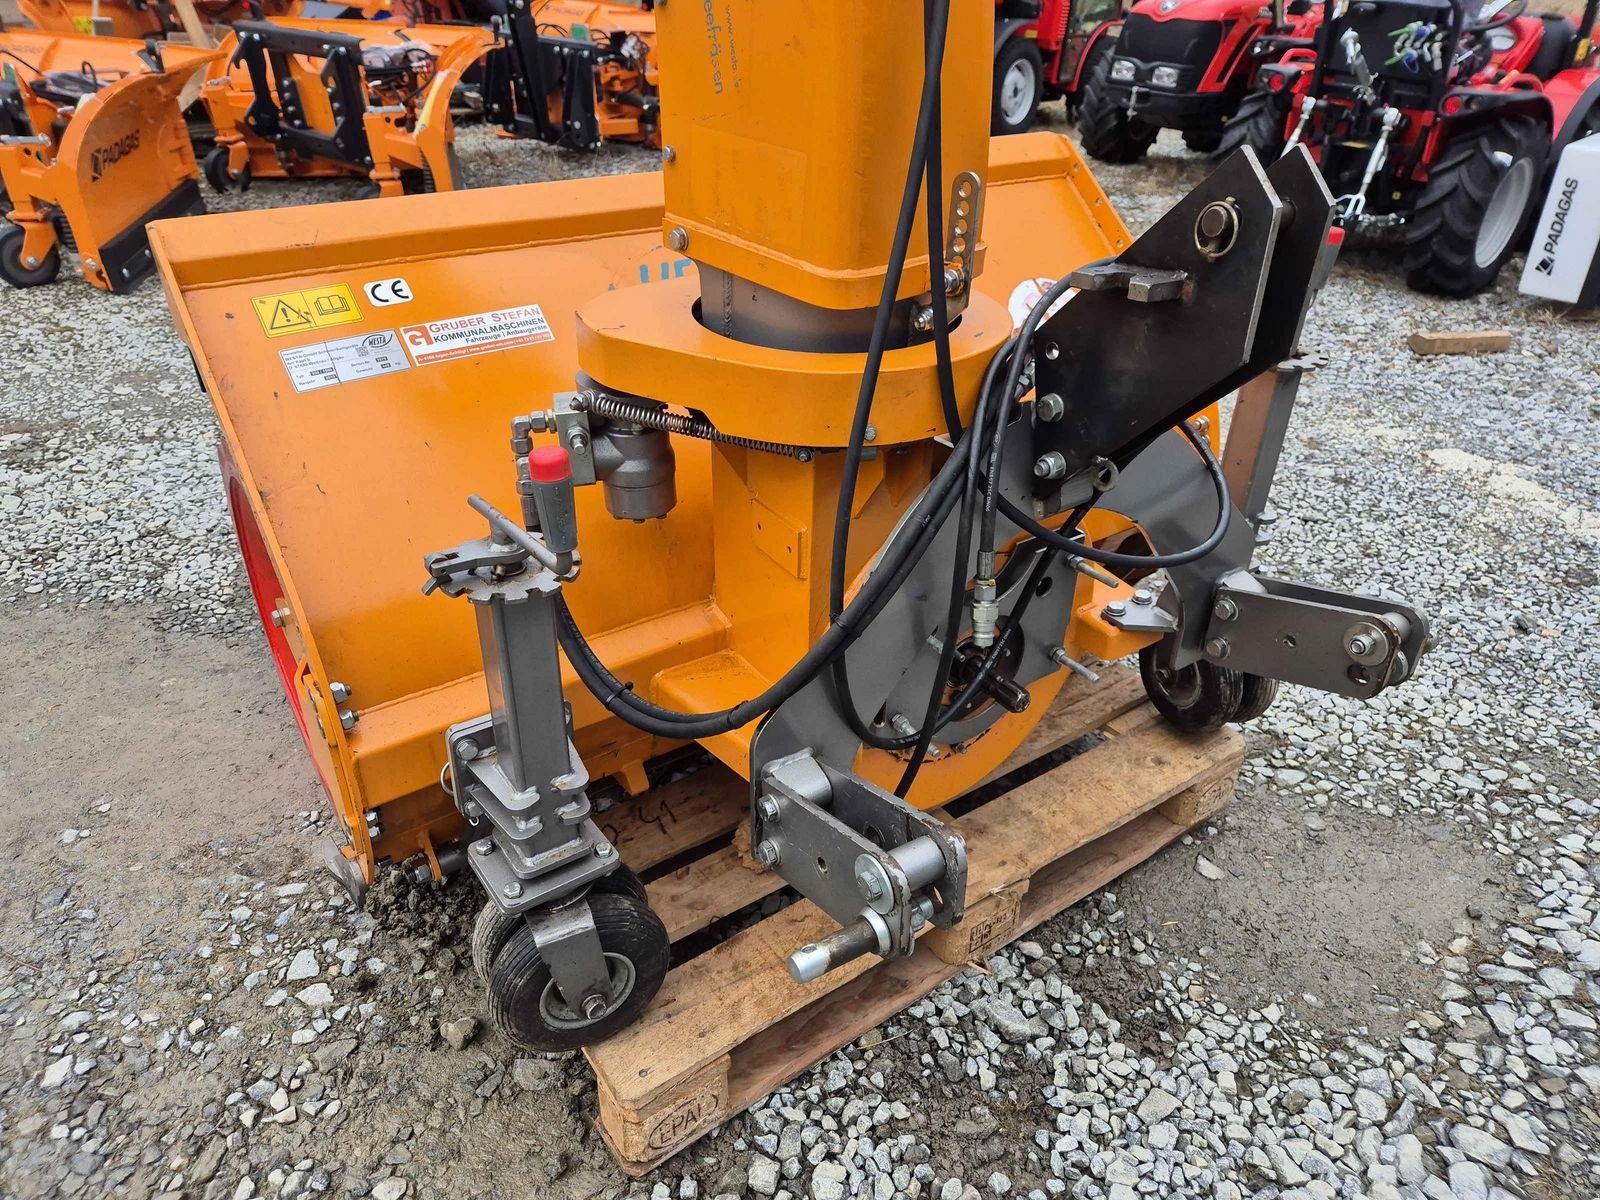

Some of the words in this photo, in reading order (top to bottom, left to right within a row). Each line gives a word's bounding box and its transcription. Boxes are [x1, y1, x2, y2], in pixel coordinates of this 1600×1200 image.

[703, 0, 723, 94] eefräsen
[1544, 178, 1579, 254] PADAGAS
[371, 279, 410, 303] CE
[428, 315, 486, 334] GRUBER
[433, 317, 545, 343] KOMMUNALMASCHINEN
[465, 333, 502, 344] Fahrzeuge
[506, 325, 548, 336] Anbaugeräte
[368, 336, 387, 347] WESTA
